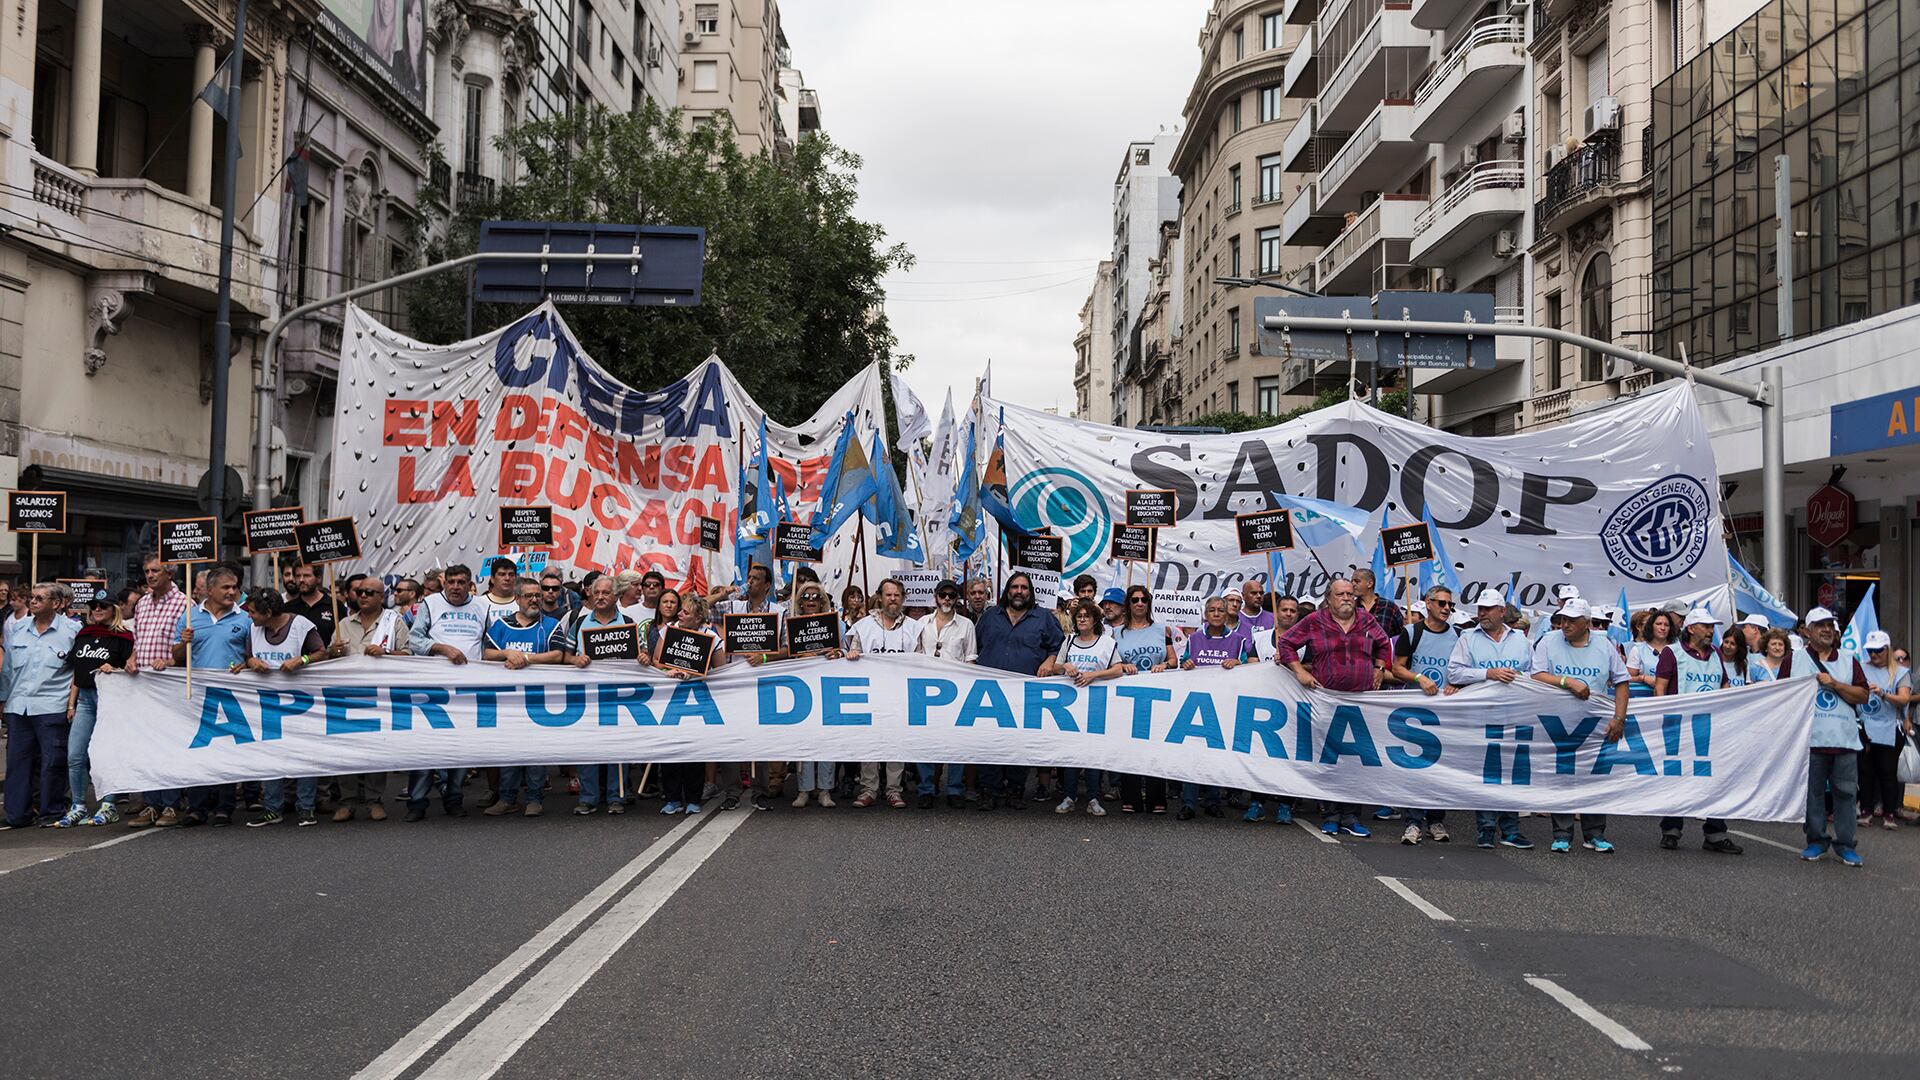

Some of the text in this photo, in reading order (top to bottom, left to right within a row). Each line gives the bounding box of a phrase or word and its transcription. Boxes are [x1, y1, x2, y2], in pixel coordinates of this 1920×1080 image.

[383, 399, 479, 447] EN
[493, 395, 730, 494] DEFENSA
[1131, 433, 1599, 536] SADOP
[15, 496, 58, 506] SALARIOS
[398, 455, 478, 505] LA
[499, 451, 815, 548] EDUCACI
[19, 509, 53, 518] DIGNOS
[255, 513, 298, 523] CONTINUIDAD
[1808, 498, 1845, 534] Delgado
[1653, 482, 1696, 499] GENERAL
[1685, 519, 1704, 564] RABAJO
[310, 533, 343, 544] AL CIERRE
[1252, 532, 1273, 540] TECHO
[1401, 536, 1420, 545] CIERRE
[171, 543, 203, 551] EDUCATIVO
[892, 574, 940, 582] PARITARIA
[905, 587, 936, 595] CIONA
[1154, 593, 1200, 602] PARITARIA
[491, 609, 513, 617] TER
[1154, 606, 1200, 615] NACIONAL
[807, 626, 828, 635] CIERRE
[590, 630, 631, 643] SALARIOS
[76, 644, 110, 660] Salta
[594, 643, 628, 655] DIGNOS
[666, 647, 674, 655] DE
[672, 641, 701, 653] AL CIERRE
[1124, 645, 1162, 659] SADOP
[1412, 655, 1449, 666] SADO
[1479, 659, 1520, 669] SADOP
[1554, 665, 1601, 677] SADOP
[188, 681, 724, 749] APERTURA
[757, 674, 873, 727] DE
[906, 677, 1443, 770] PARITARIAS
